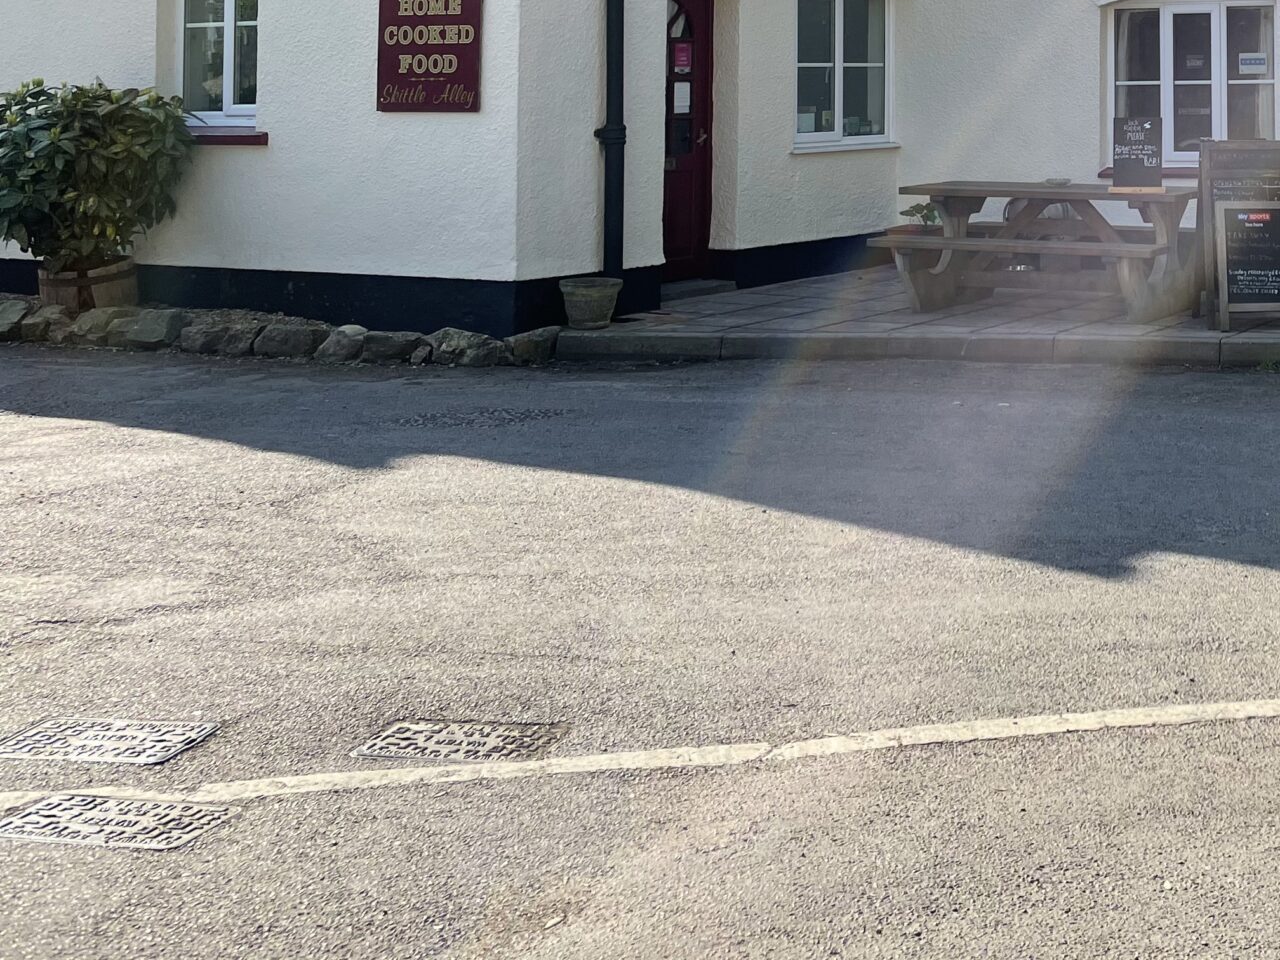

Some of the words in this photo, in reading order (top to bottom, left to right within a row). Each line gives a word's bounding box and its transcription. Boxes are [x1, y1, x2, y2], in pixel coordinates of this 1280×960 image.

[384, 25, 475, 45] COOKED
[398, 54, 458, 74] FOOD
[382, 83, 426, 104] Skittle
[433, 83, 475, 109] Alley
